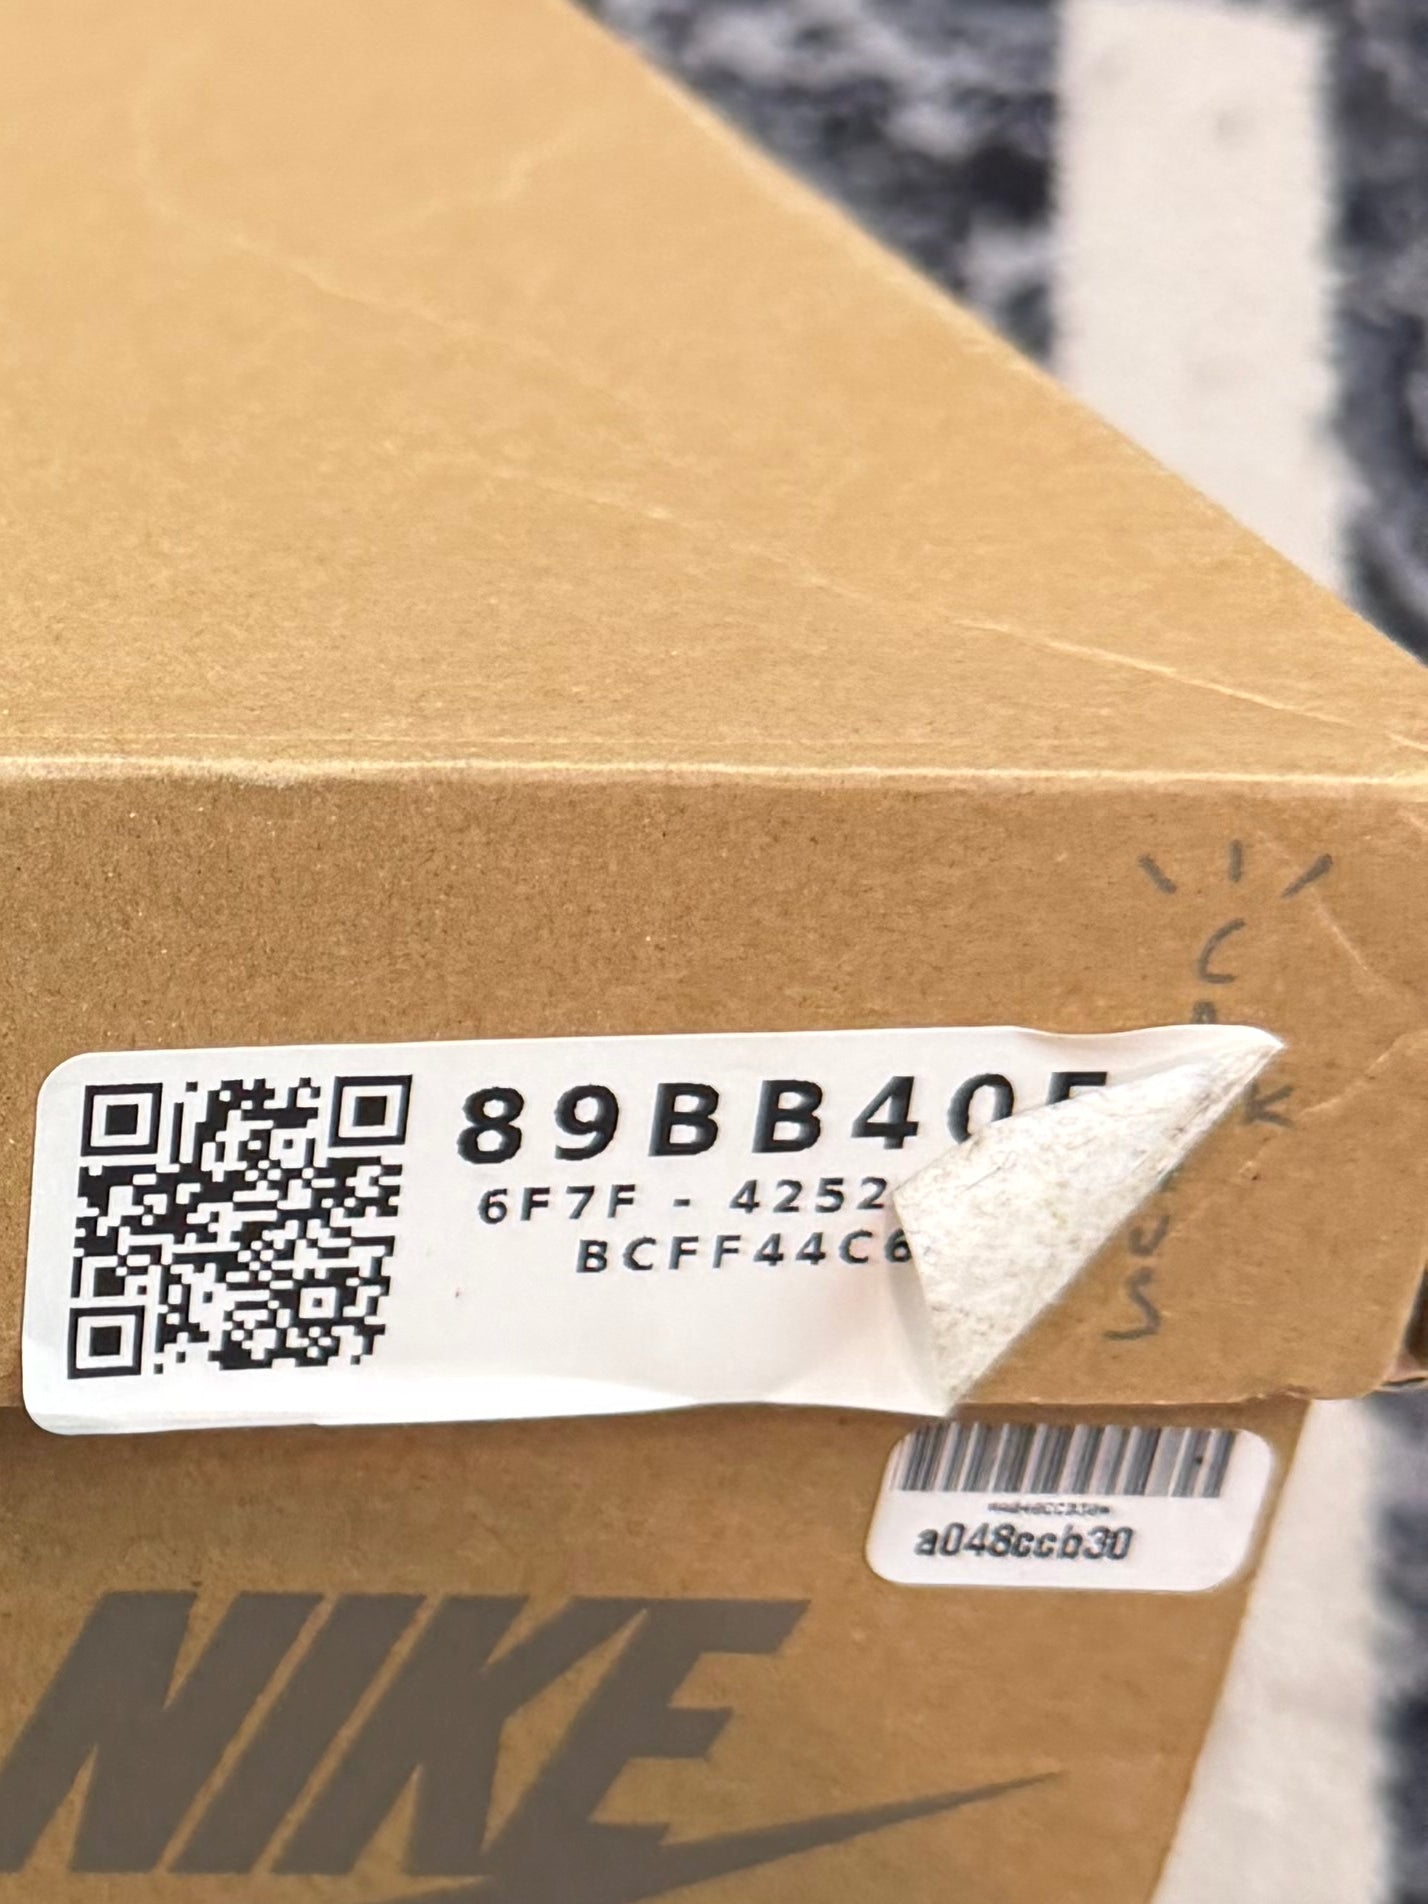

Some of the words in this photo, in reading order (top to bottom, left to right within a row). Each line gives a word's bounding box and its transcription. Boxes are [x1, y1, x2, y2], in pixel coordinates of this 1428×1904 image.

[476, 1183, 638, 1226] 6F7F
[728, 1176, 890, 1215] 4252
[912, 1521, 1134, 1561] a048ccb30
